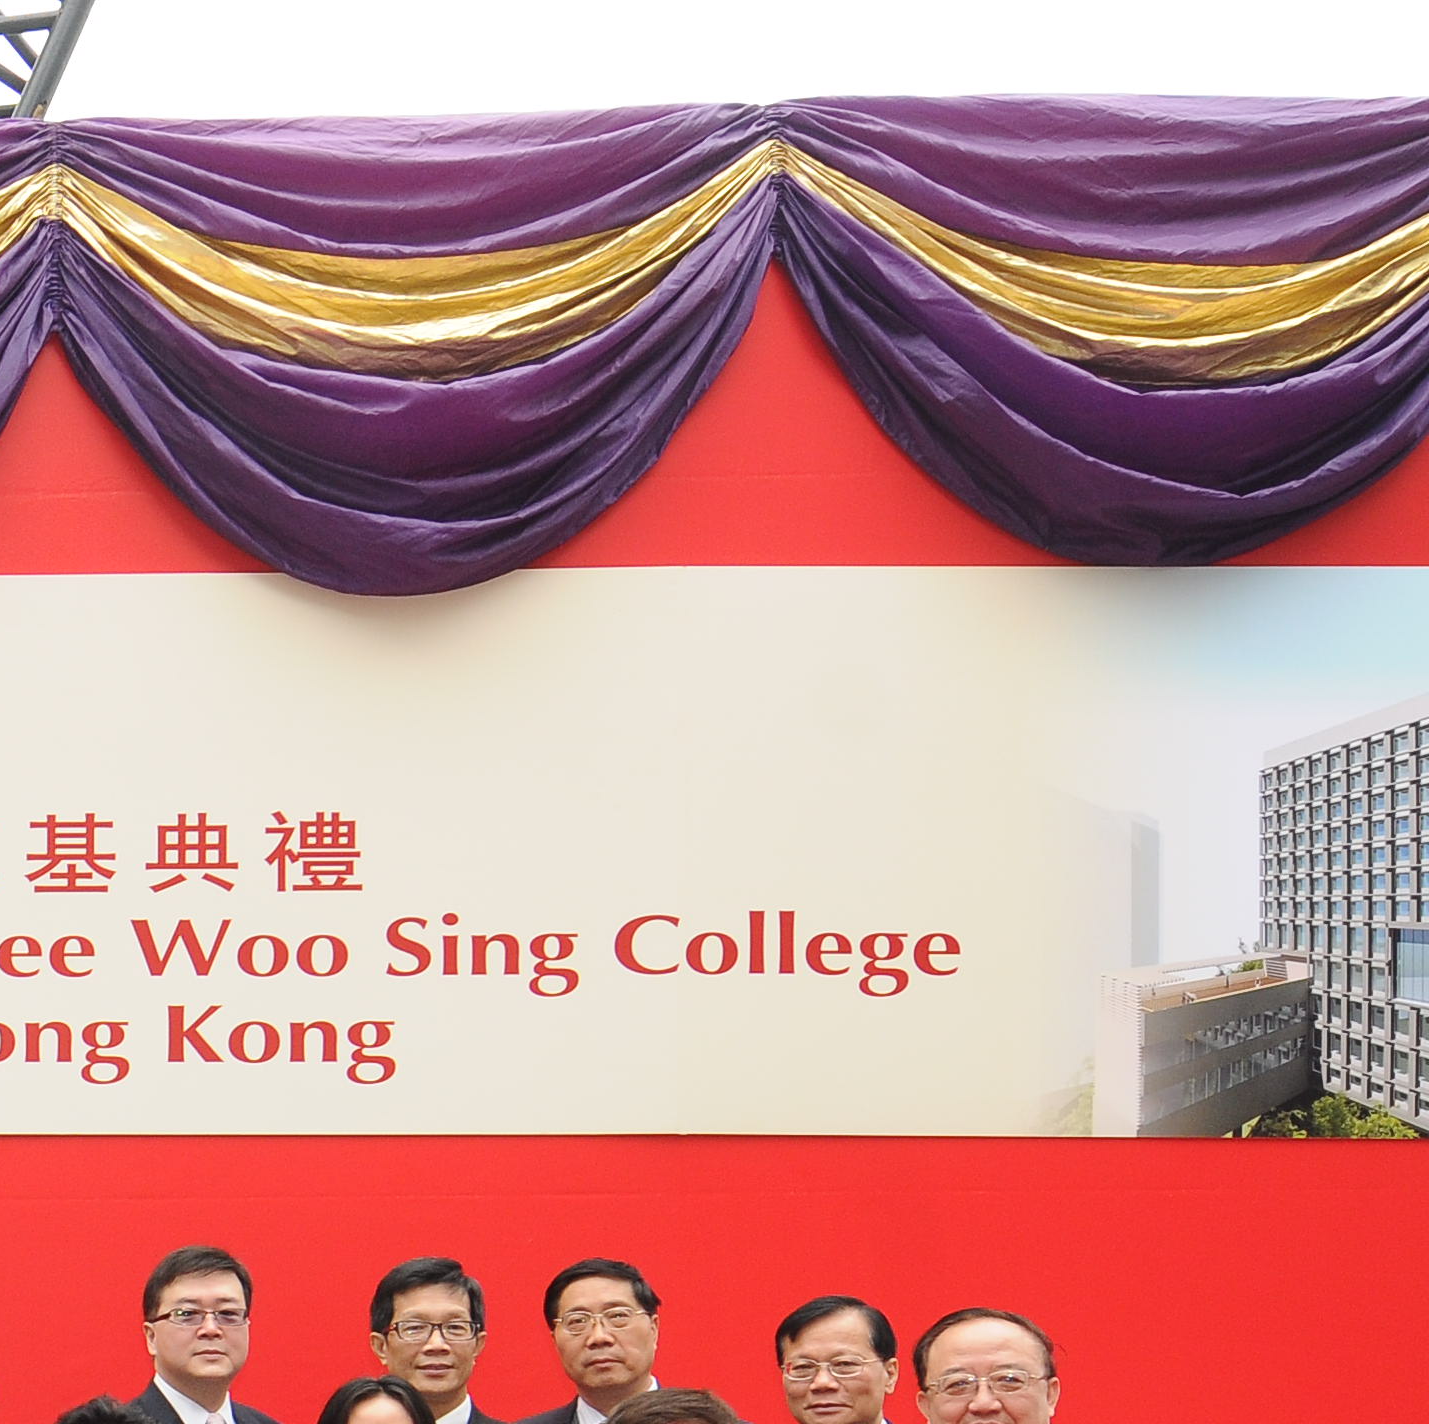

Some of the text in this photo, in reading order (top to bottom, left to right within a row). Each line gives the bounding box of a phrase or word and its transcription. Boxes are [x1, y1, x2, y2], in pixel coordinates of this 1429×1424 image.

[132, 920, 348, 977] Woo
[386, 913, 579, 997] Sing
[614, 911, 961, 997] College
[168, 1005, 396, 1084] Kong
